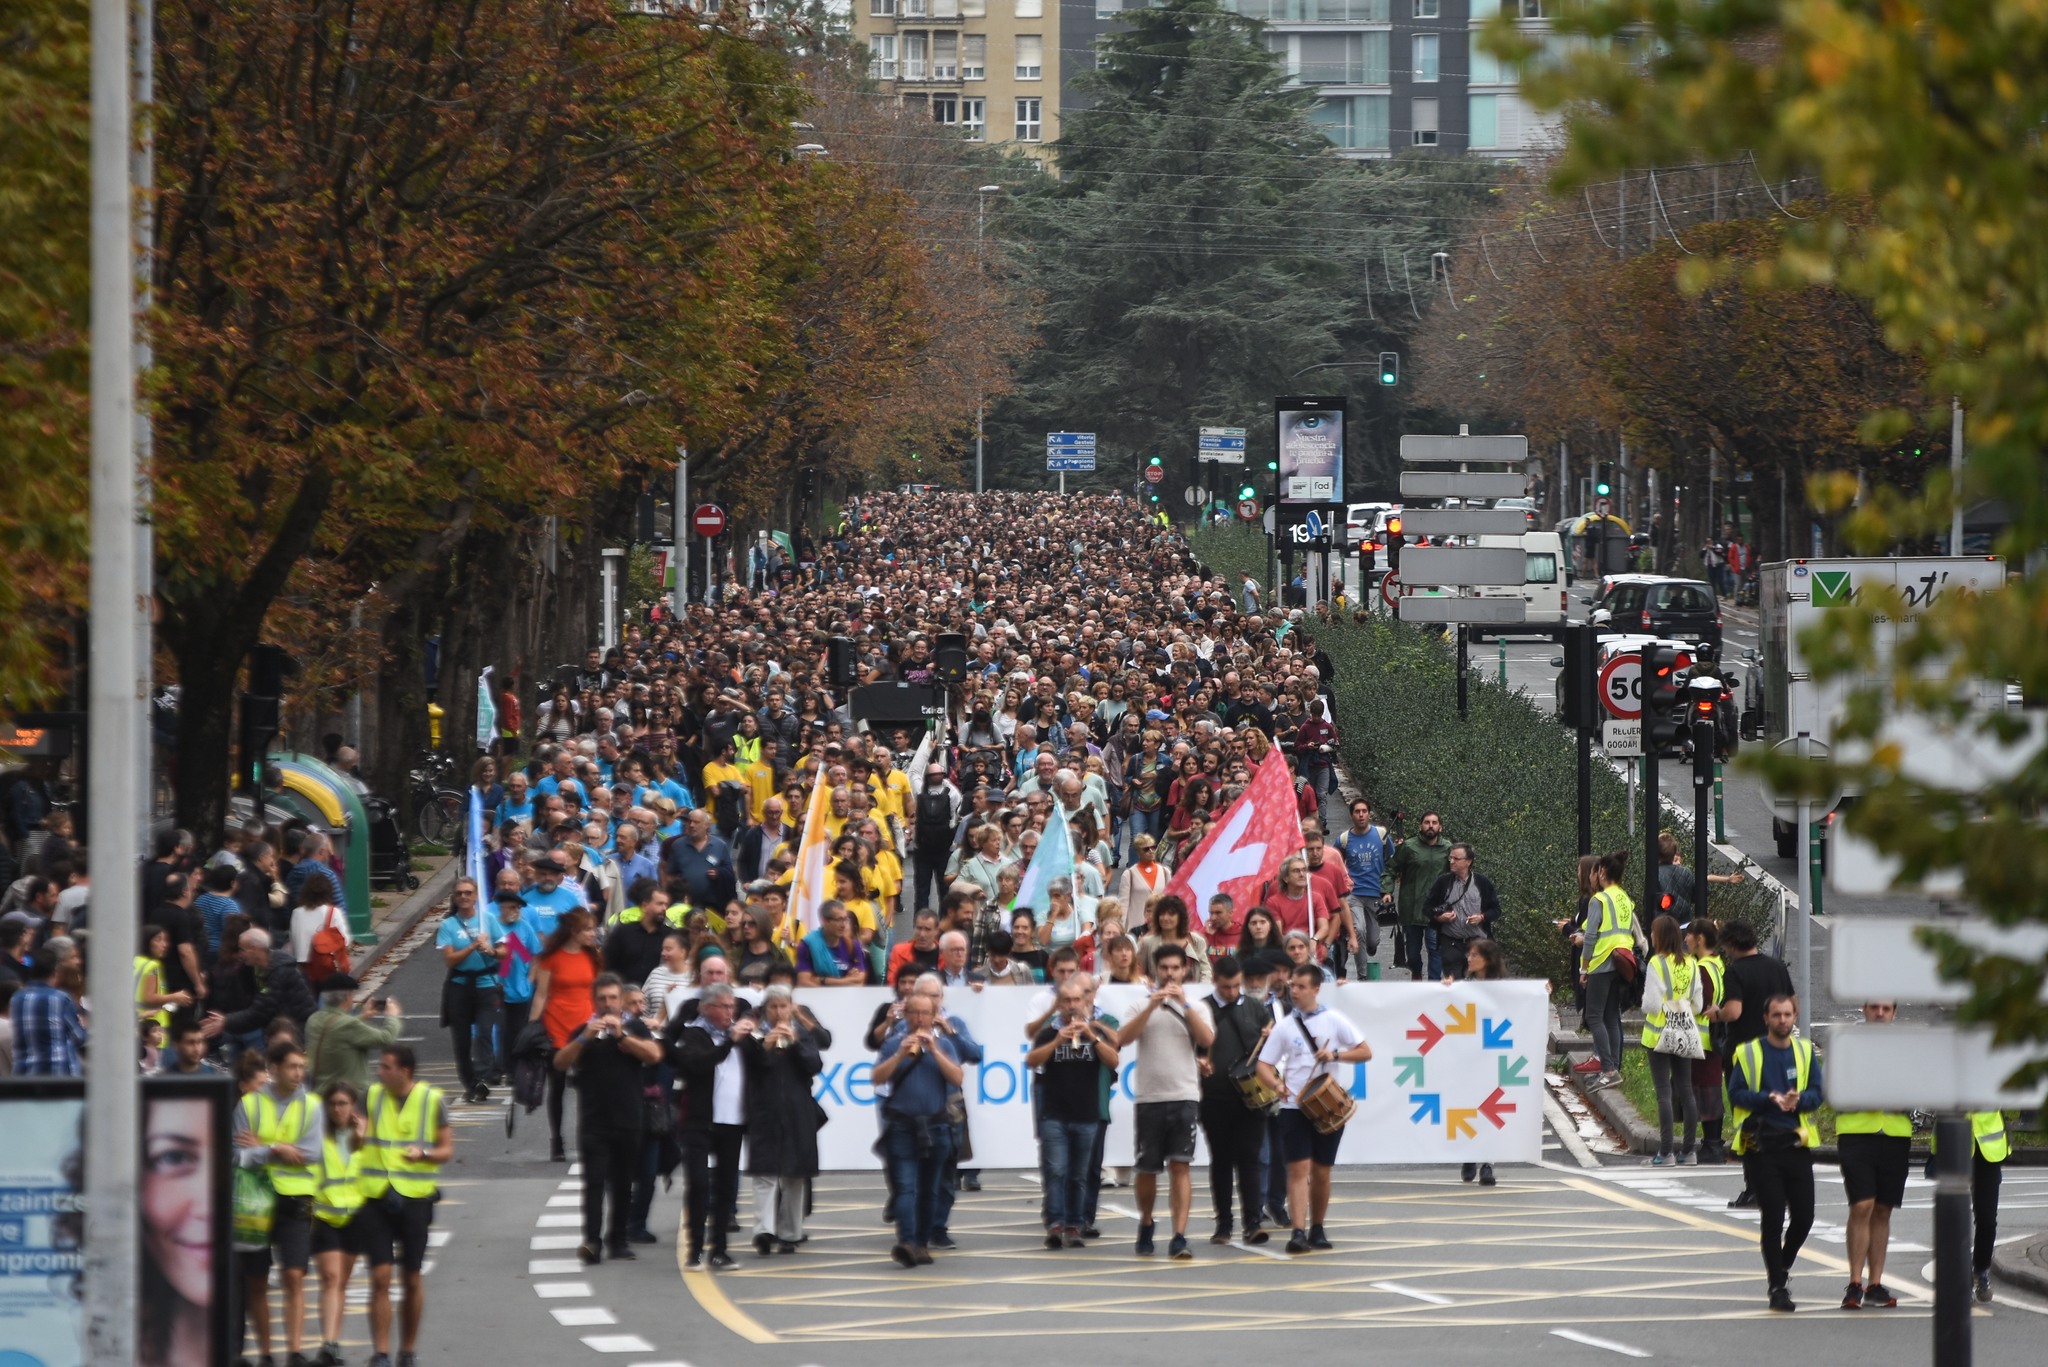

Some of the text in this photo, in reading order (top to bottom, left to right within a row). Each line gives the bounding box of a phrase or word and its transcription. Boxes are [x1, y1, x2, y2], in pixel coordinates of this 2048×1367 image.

[1295, 433, 1327, 441] Nuestra
[1286, 440, 1336, 449] adolescencia
[1314, 481, 1330, 490] fad
[1611, 677, 1642, 700] 50
